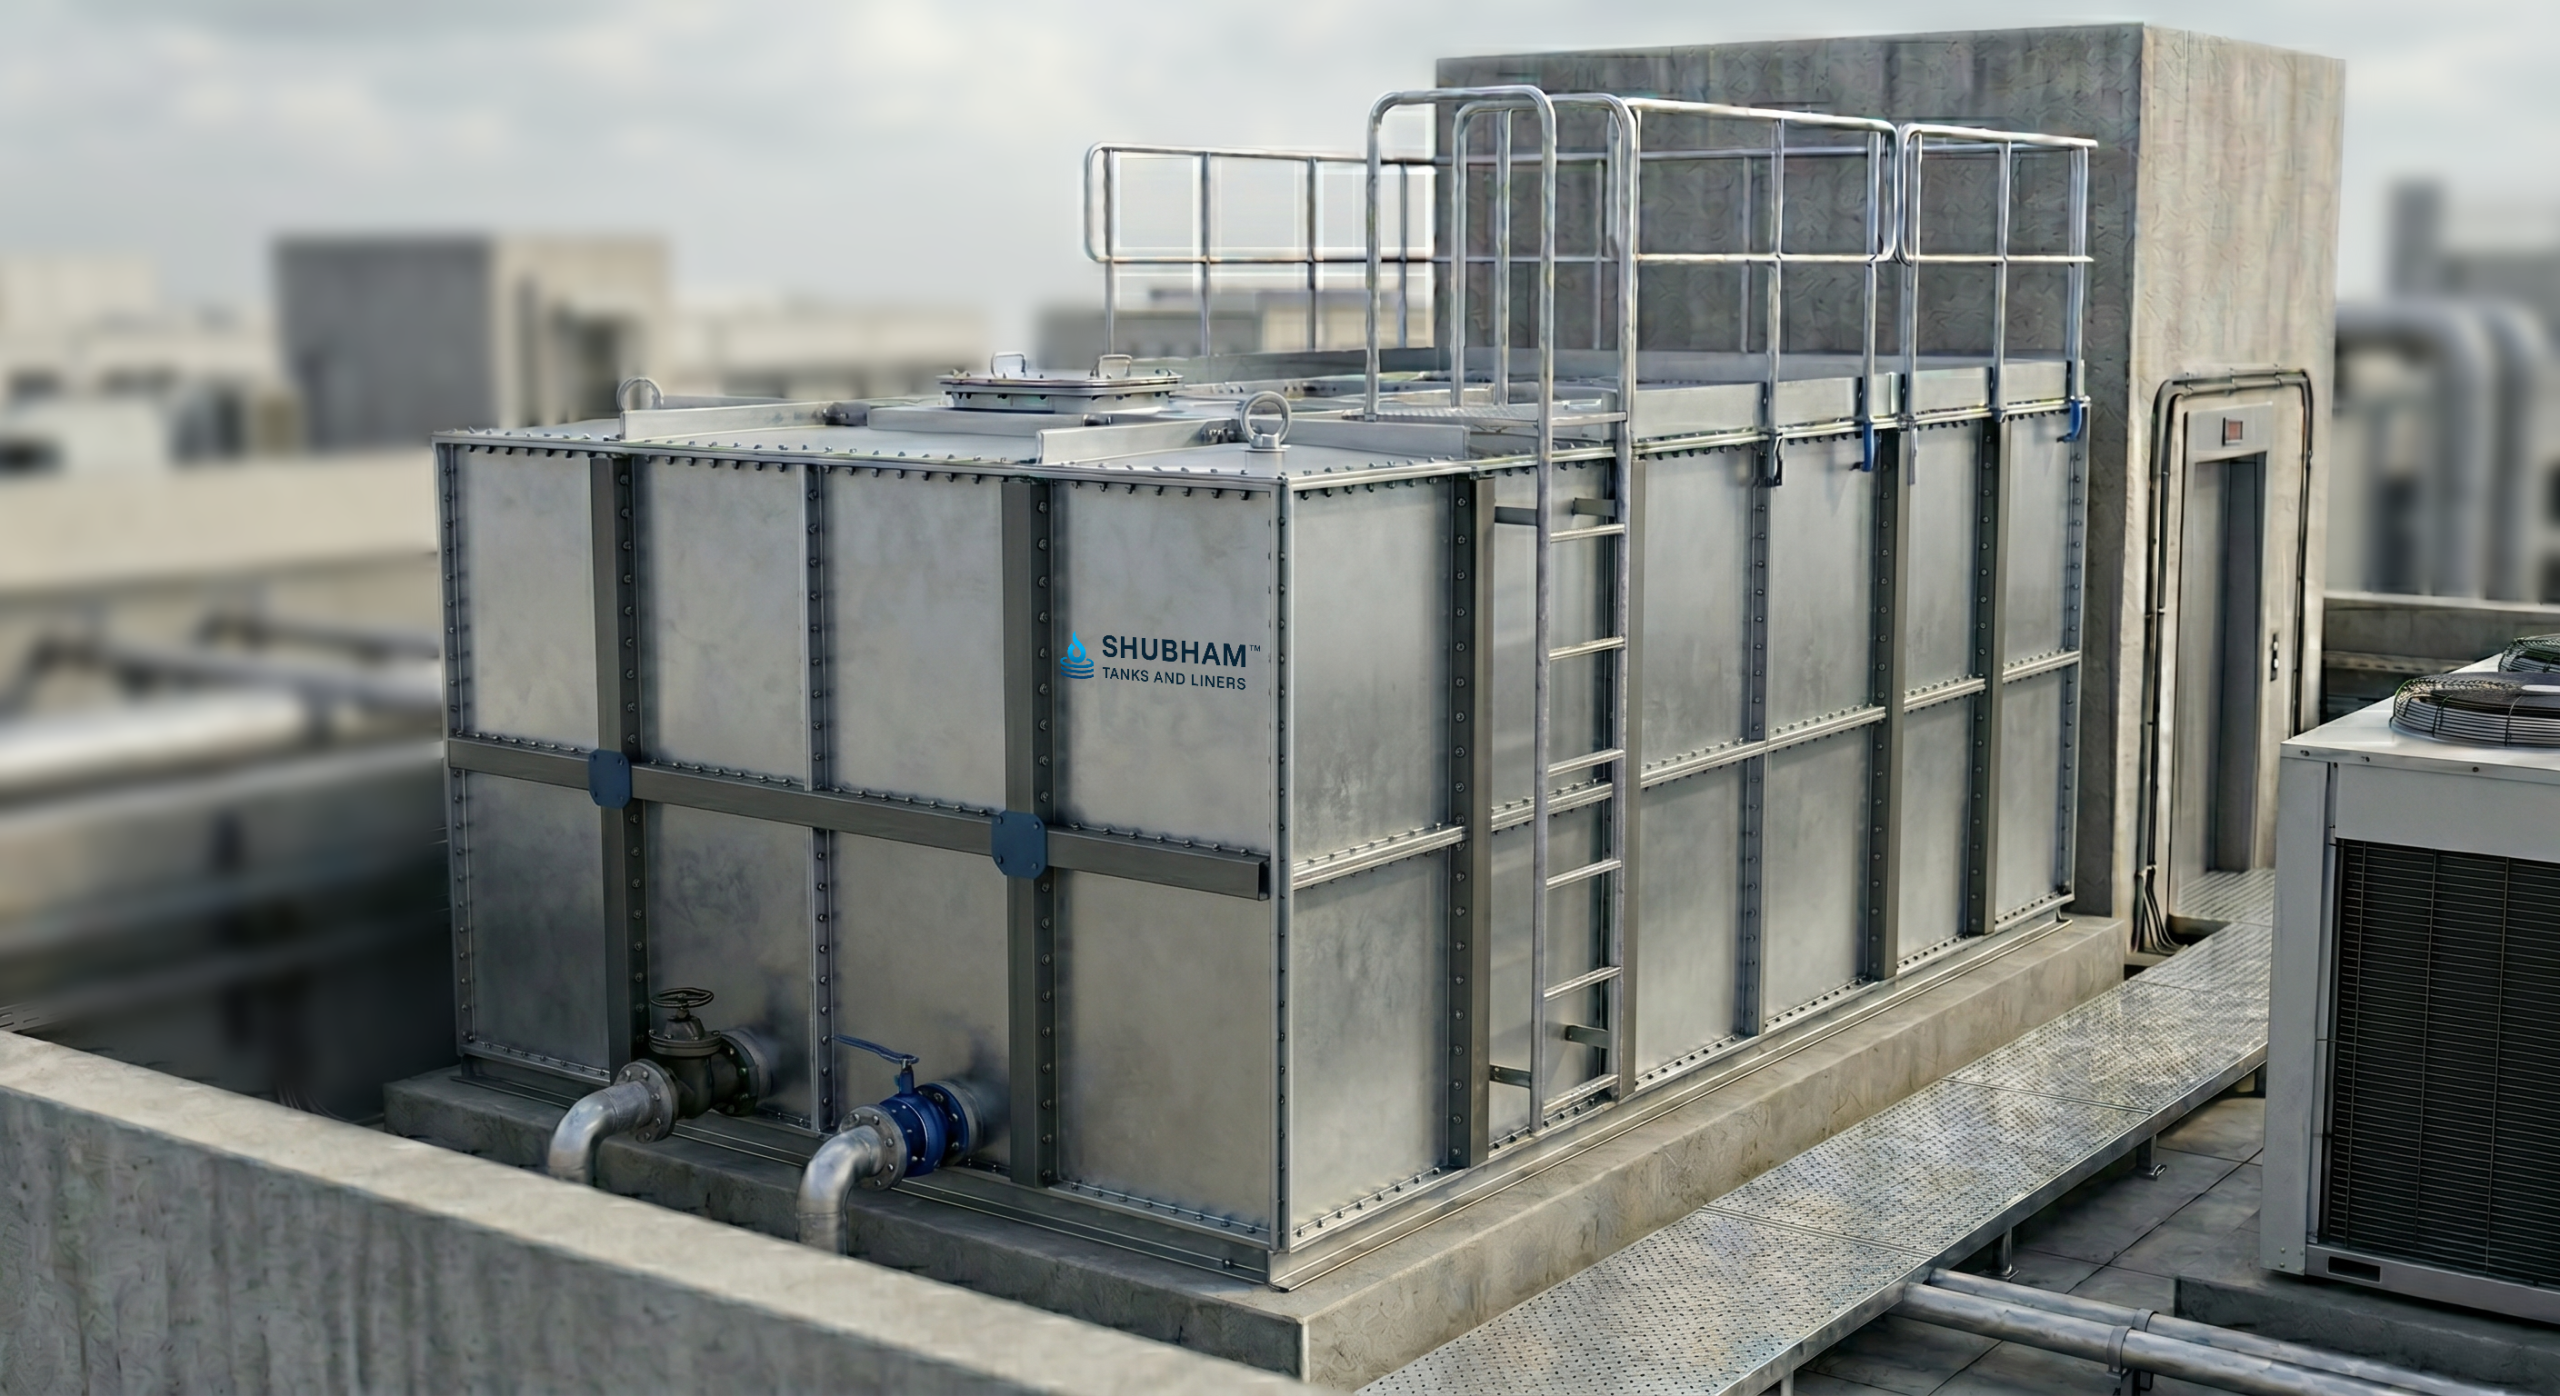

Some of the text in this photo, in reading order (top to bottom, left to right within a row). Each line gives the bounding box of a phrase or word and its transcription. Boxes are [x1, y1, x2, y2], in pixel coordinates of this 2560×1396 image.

[1102, 666, 1247, 691] TANKS AND LINERS
